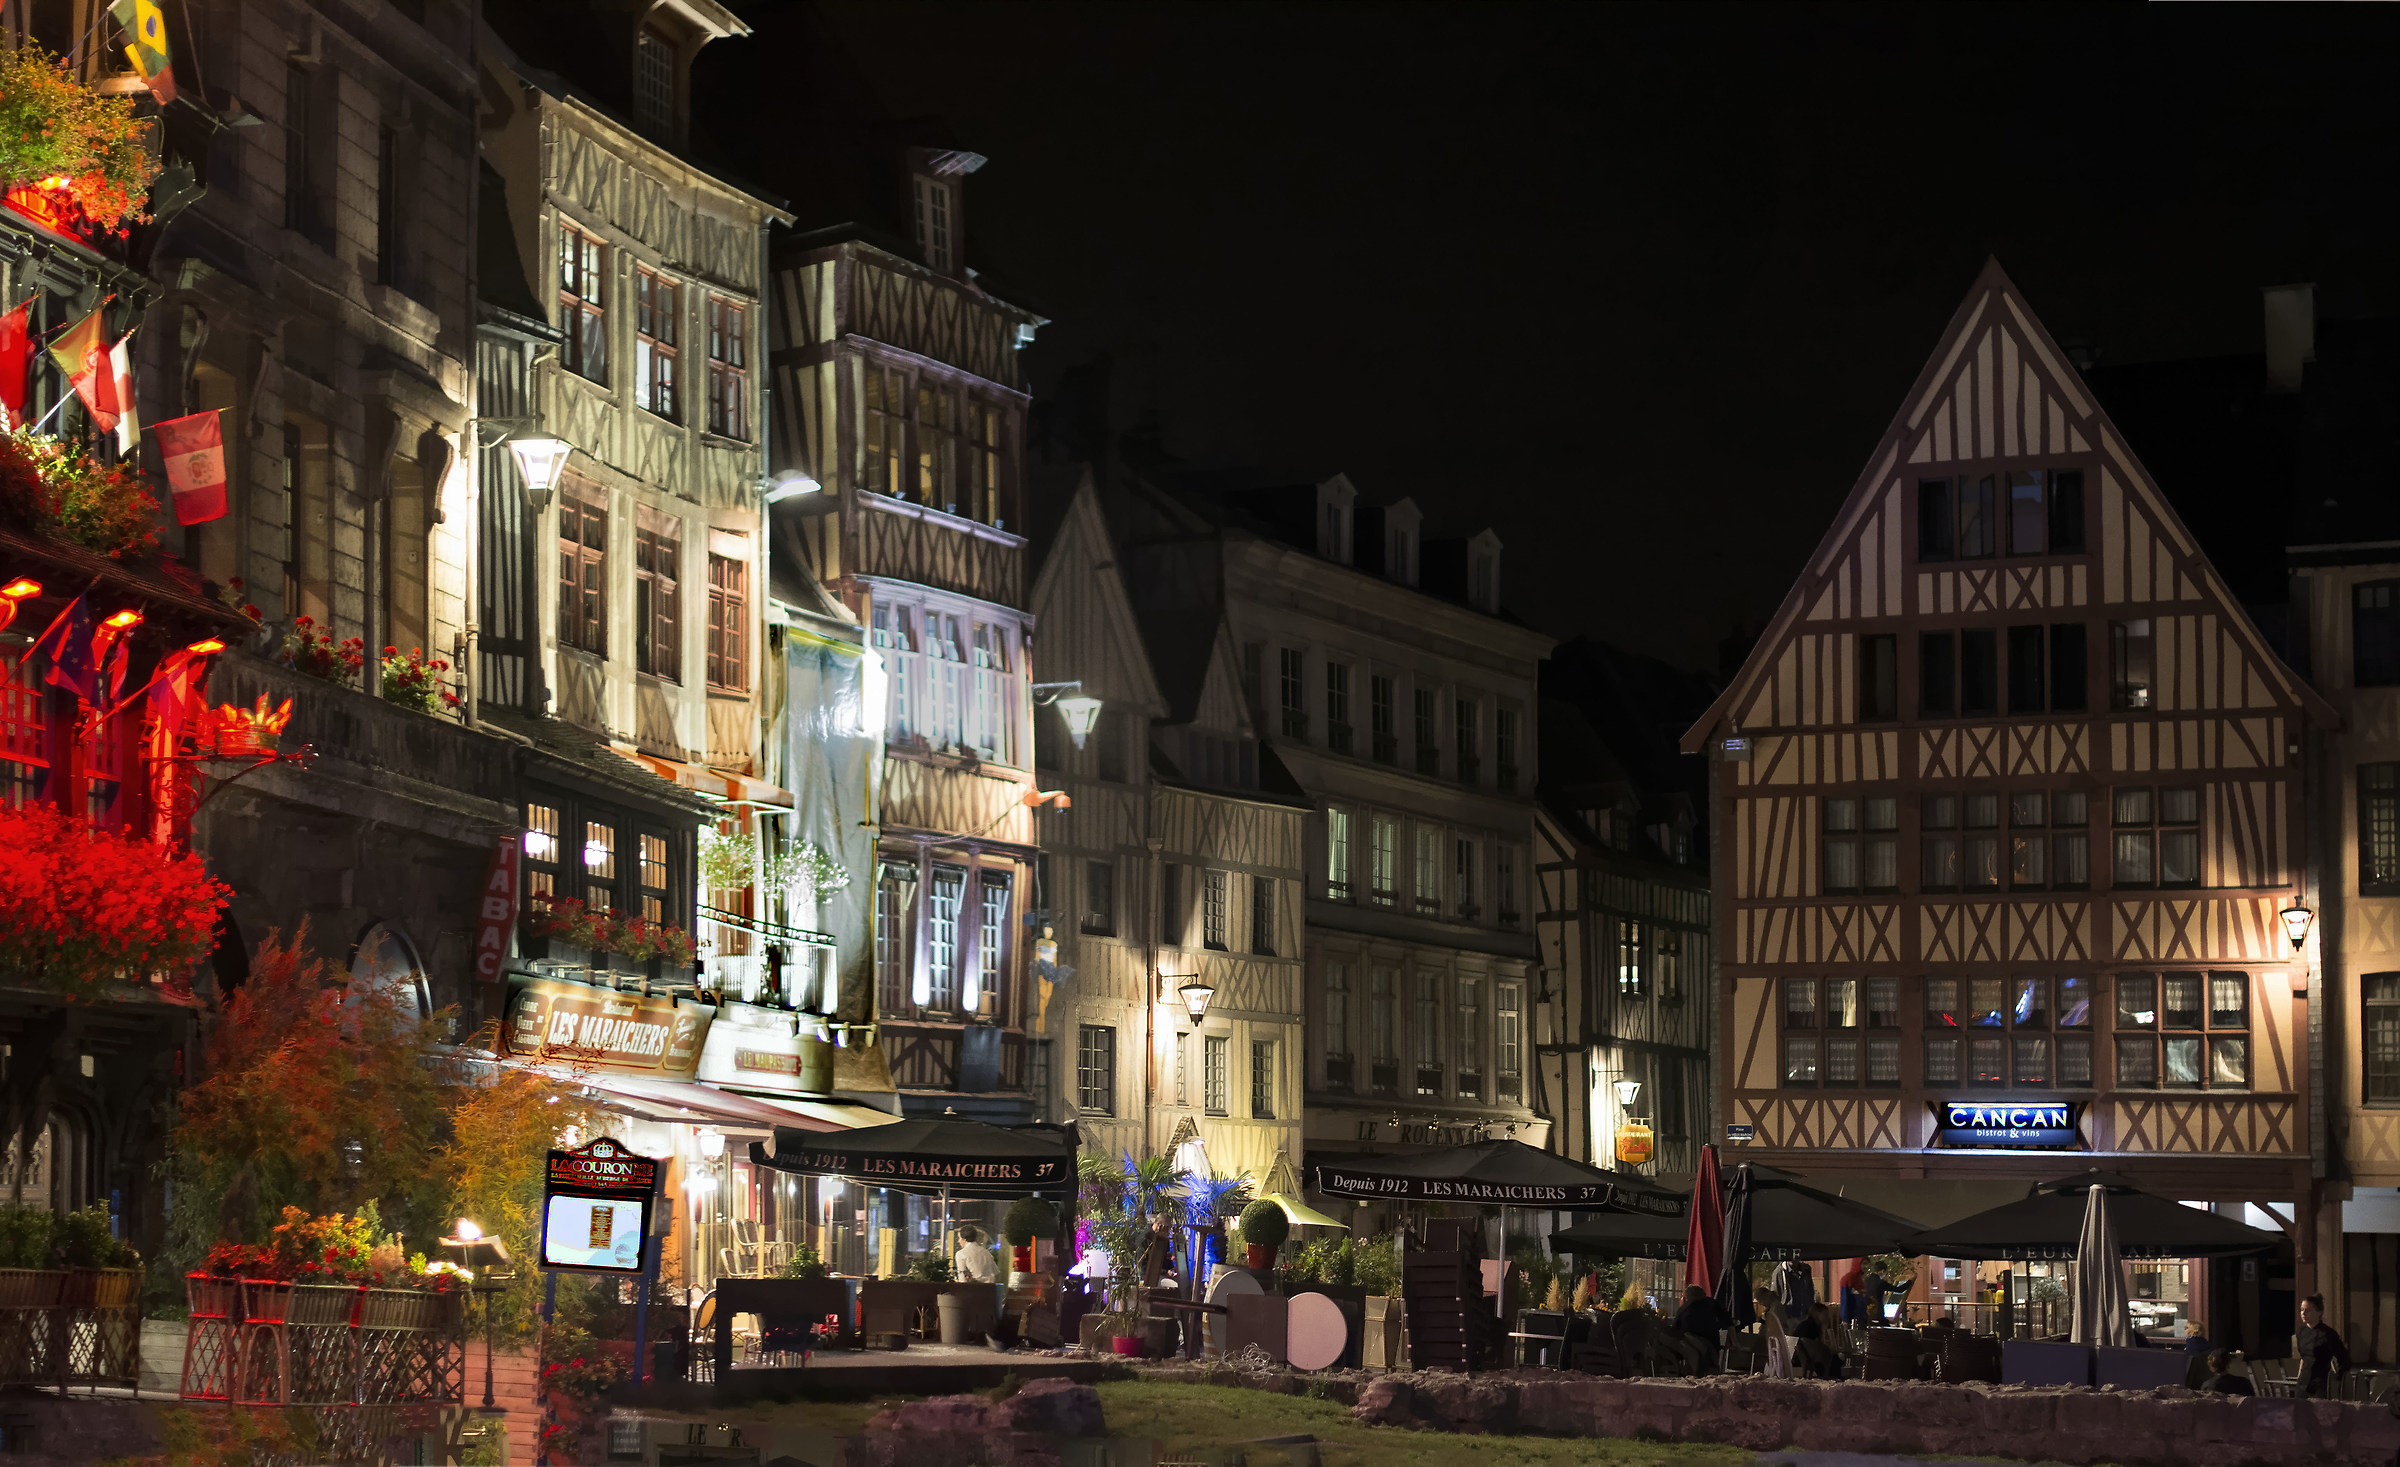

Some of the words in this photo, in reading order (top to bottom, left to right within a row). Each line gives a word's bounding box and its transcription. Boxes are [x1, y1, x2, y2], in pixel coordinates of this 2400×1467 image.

[478, 841, 513, 975] TABAC
[547, 1010, 579, 1045] LES
[578, 1015, 669, 1057] MARAICHERS
[1950, 1109, 2067, 1127] CANCAN
[1358, 1121, 1378, 1141] LE
[1977, 1129, 2006, 1137] bistrot
[2009, 1128, 2019, 1138] &
[2021, 1129, 2040, 1137] vins
[550, 1159, 570, 1172] LA
[572, 1160, 653, 1177] COURONNE
[763, 1152, 810, 1166] epuis
[814, 1153, 847, 1170] 1912
[863, 1158, 896, 1174] LES
[899, 1160, 1022, 1179] MARAICHERS
[1035, 1163, 1055, 1177] 37
[1333, 1174, 1376, 1192] Depuis
[1379, 1178, 1409, 1194] 1912
[1423, 1181, 1451, 1195] LES
[1455, 1182, 1567, 1200] MARAICHERS
[1579, 1187, 1597, 1199] 37
[2001, 1247, 2074, 1260] L'EUR
[2119, 1247, 2172, 1258] AFE
[688, 1423, 708, 1445] LE
